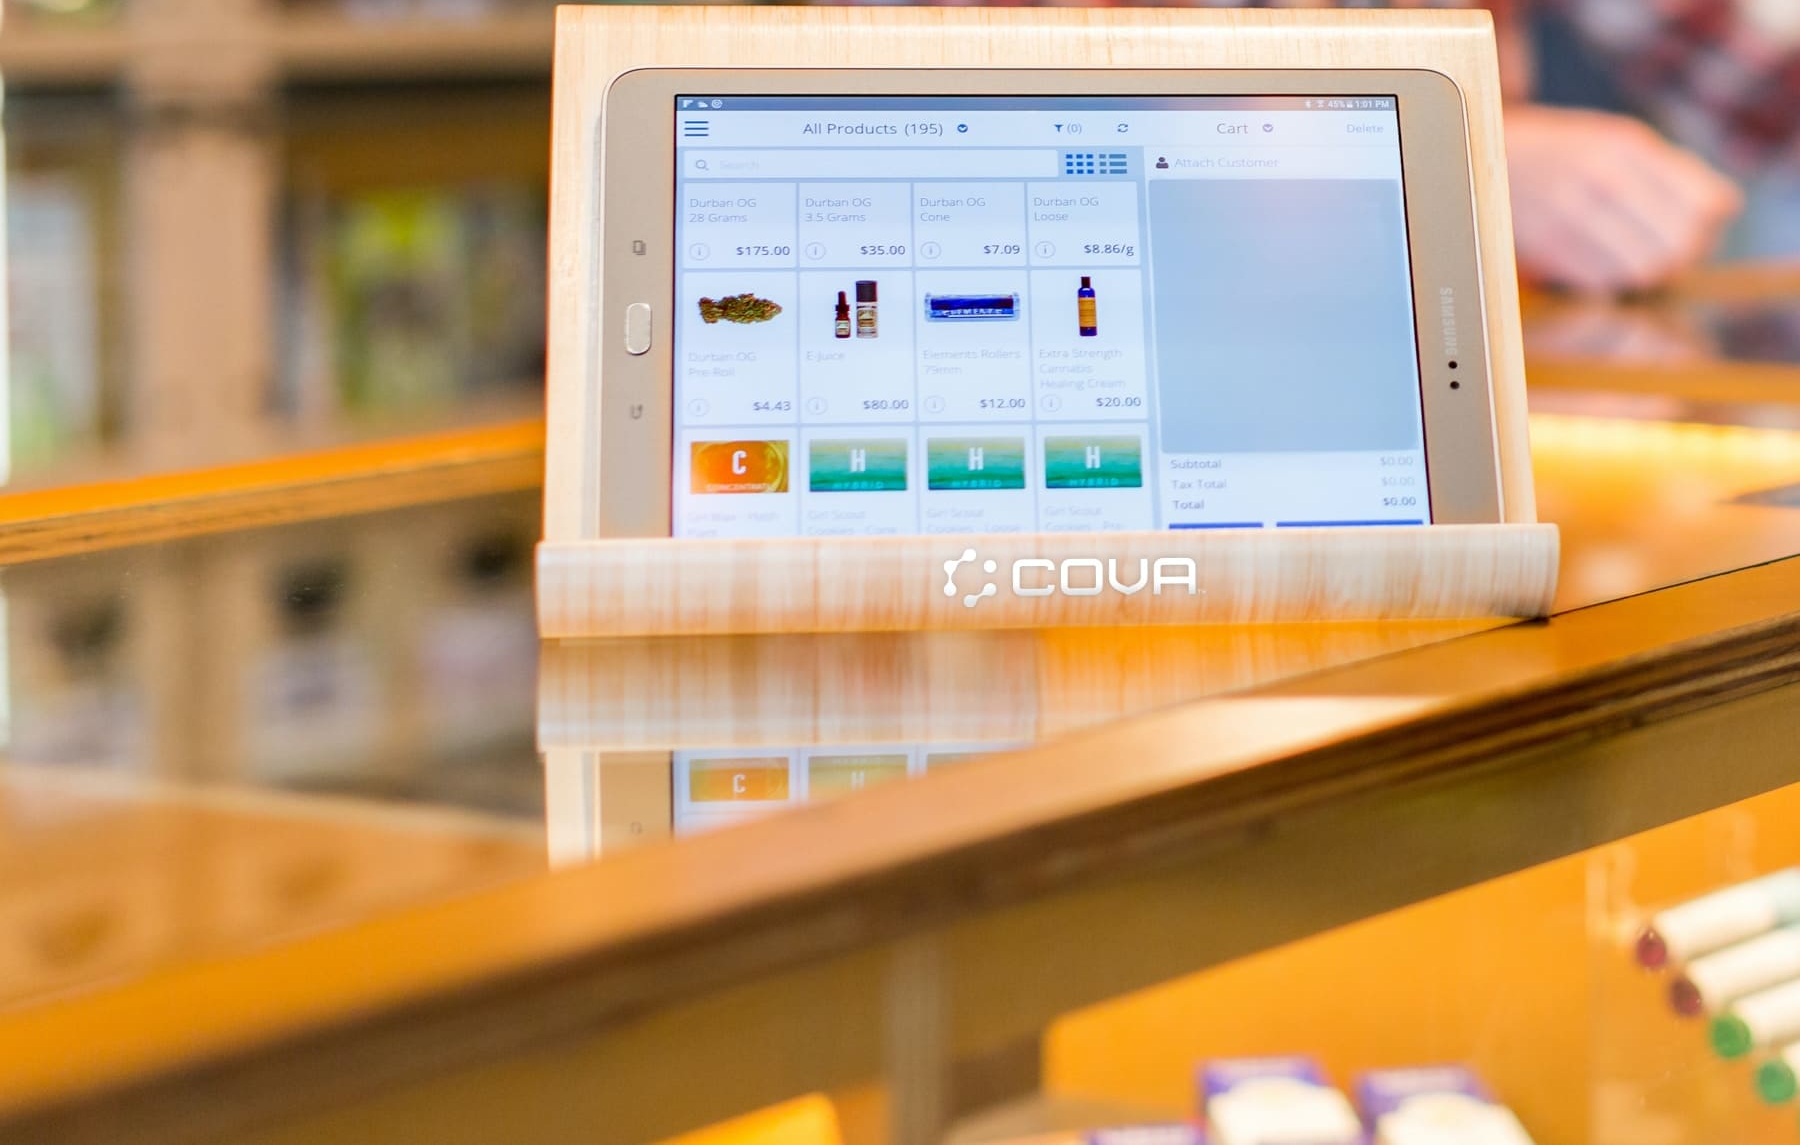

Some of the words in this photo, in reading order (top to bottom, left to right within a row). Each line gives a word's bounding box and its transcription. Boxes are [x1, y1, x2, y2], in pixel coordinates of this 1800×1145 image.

[1376, 100, 1389, 108] PM
[803, 123, 822, 135] All
[826, 123, 897, 135] Products
[904, 122, 943, 137] (195)
[1067, 122, 1082, 135] (0)
[1216, 122, 1248, 135] Cart
[1346, 123, 1384, 134] Delete
[1174, 157, 1214, 168] Attach
[1217, 157, 1278, 168] Customer
[689, 198, 734, 209] Durban
[736, 198, 756, 209] OG
[805, 197, 849, 208] Durban
[851, 197, 872, 208] OG
[920, 197, 963, 208] Durban
[966, 197, 986, 208] OG
[1034, 196, 1076, 207] Durban
[1079, 196, 1099, 207] OG
[689, 212, 704, 223] 28
[708, 212, 747, 223] Grams
[805, 212, 823, 223] 3.5
[827, 212, 866, 223] Grams
[920, 211, 951, 222] Cone
[1034, 211, 1068, 222] Loose
[736, 244, 790, 257] $175.00
[860, 244, 906, 257] $35.00
[984, 244, 1020, 256] $7.09
[1084, 243, 1134, 257] $8.86/g
[1440, 287, 1458, 355] SAMSUNG
[736, 351, 756, 362] OG
[923, 349, 978, 360] Elements
[981, 349, 1021, 360] Rollers
[1039, 349, 1069, 360] Extra
[1072, 348, 1122, 361] Strength
[752, 400, 791, 412] $4.43
[863, 399, 909, 411] $80.00
[980, 398, 1026, 410] $12.00
[1096, 396, 1141, 408] $20.00
[732, 450, 747, 475] C
[851, 449, 866, 472] H
[968, 447, 984, 471] H
[1085, 446, 1101, 469] H
[1380, 456, 1413, 467] $0.00
[1170, 459, 1222, 469] Subtotal
[951, 479, 1002, 488] HYBRID
[1069, 478, 1120, 487] HYBRID
[1171, 478, 1193, 489] Tax
[1197, 478, 1227, 489] Total
[1174, 499, 1204, 510] Total
[1383, 496, 1416, 507] $0.00
[1012, 557, 1197, 597] COVA
